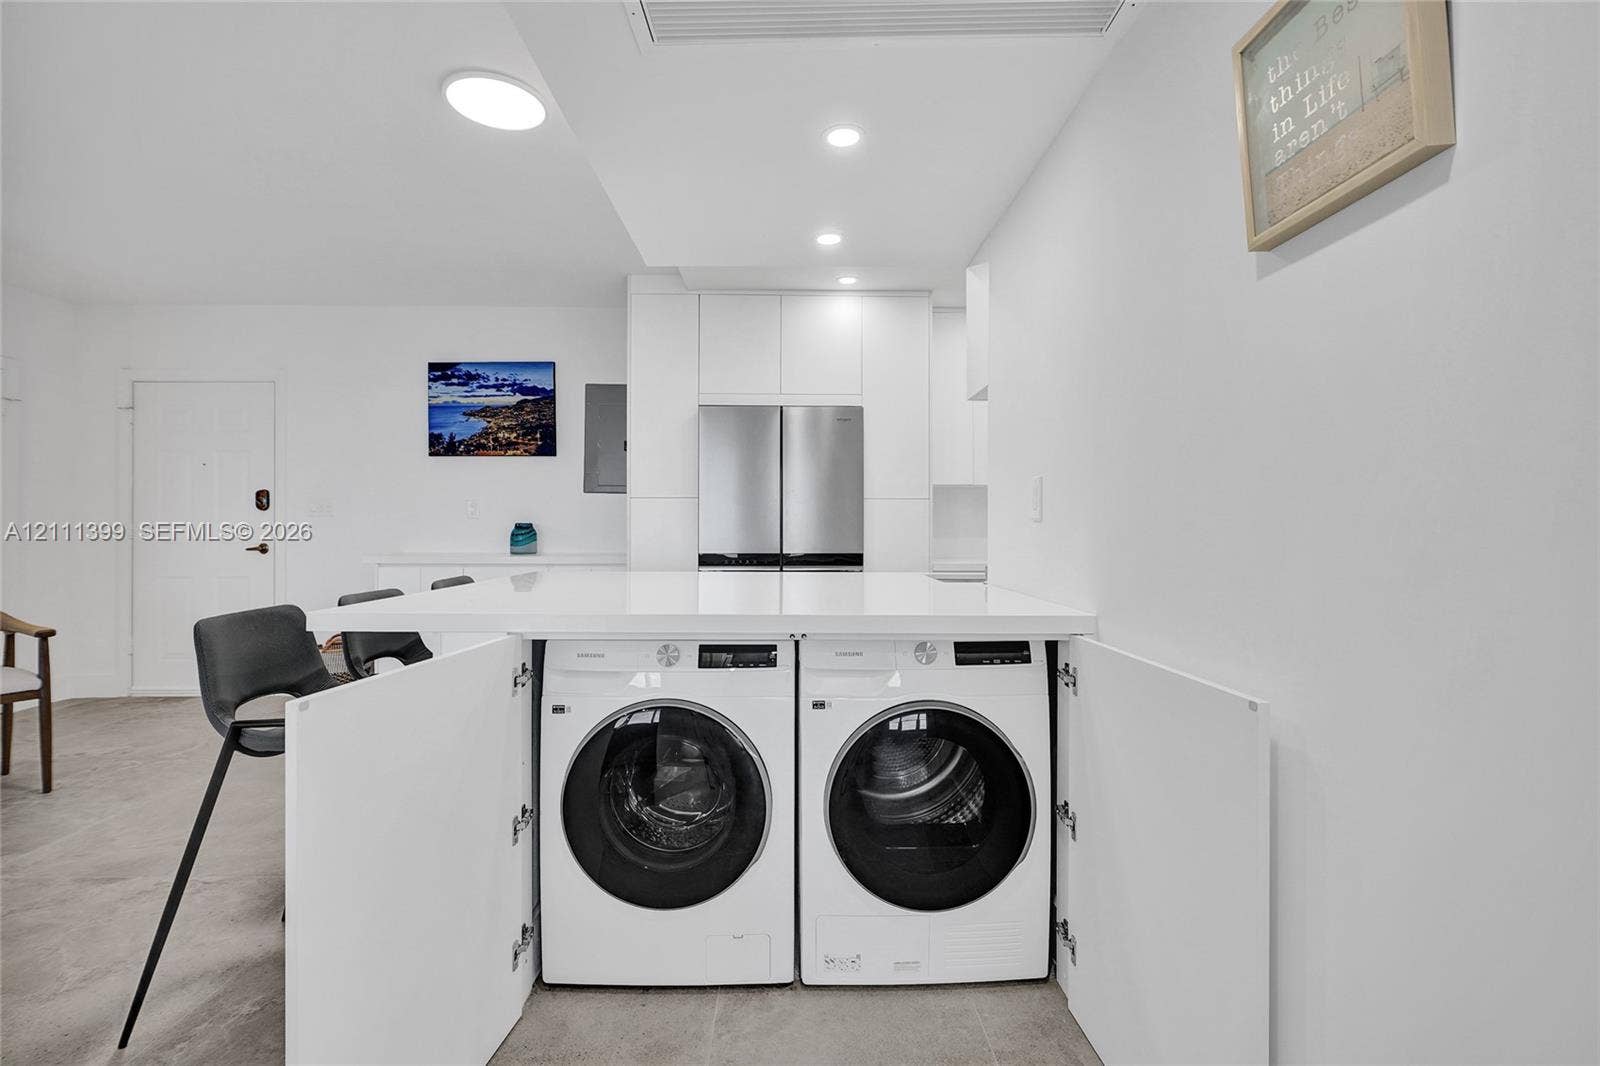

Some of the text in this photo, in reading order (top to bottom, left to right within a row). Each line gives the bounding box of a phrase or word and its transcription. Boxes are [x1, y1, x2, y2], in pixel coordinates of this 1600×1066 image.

[1270, 44, 1342, 113] thin
[1271, 72, 1351, 143] in Life
